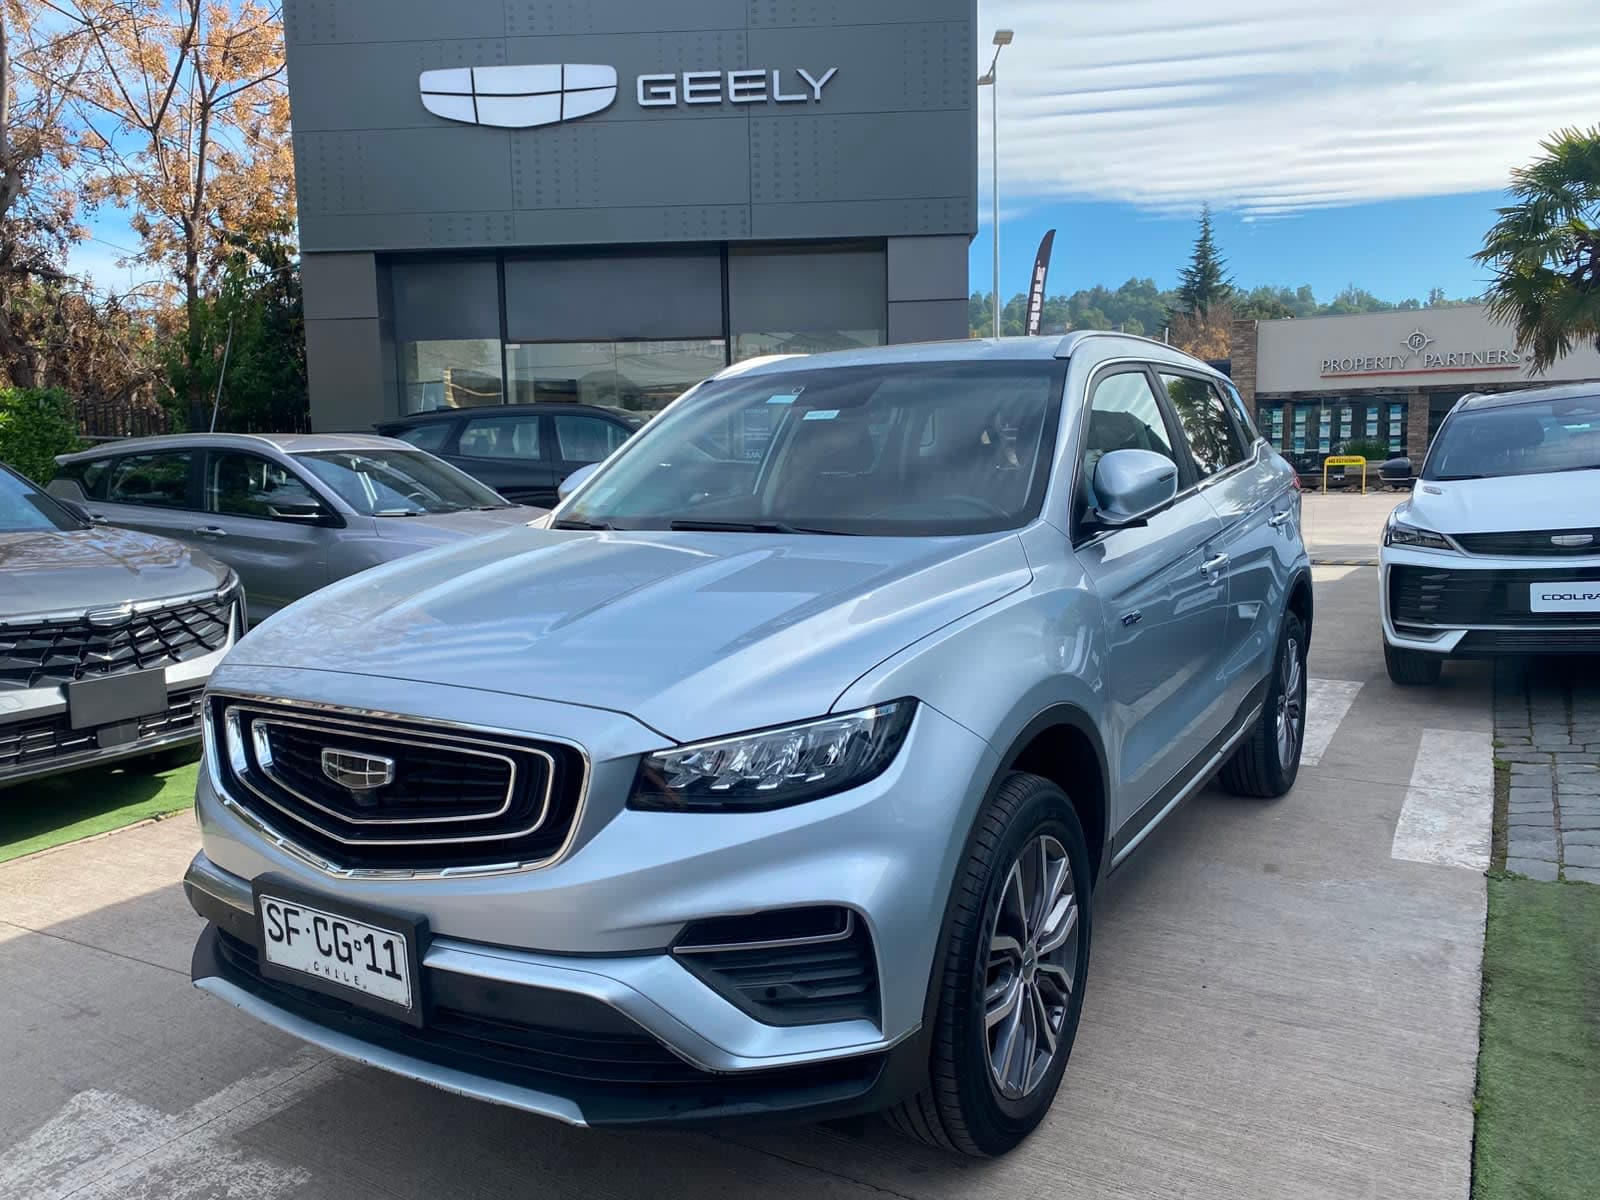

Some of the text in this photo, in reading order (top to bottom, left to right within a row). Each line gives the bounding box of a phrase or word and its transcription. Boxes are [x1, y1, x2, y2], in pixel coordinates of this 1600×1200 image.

[637, 67, 838, 107] GEELY
[1320, 350, 1521, 372] PROPERTY PARTNERS
[313, 961, 360, 986] CHILE
